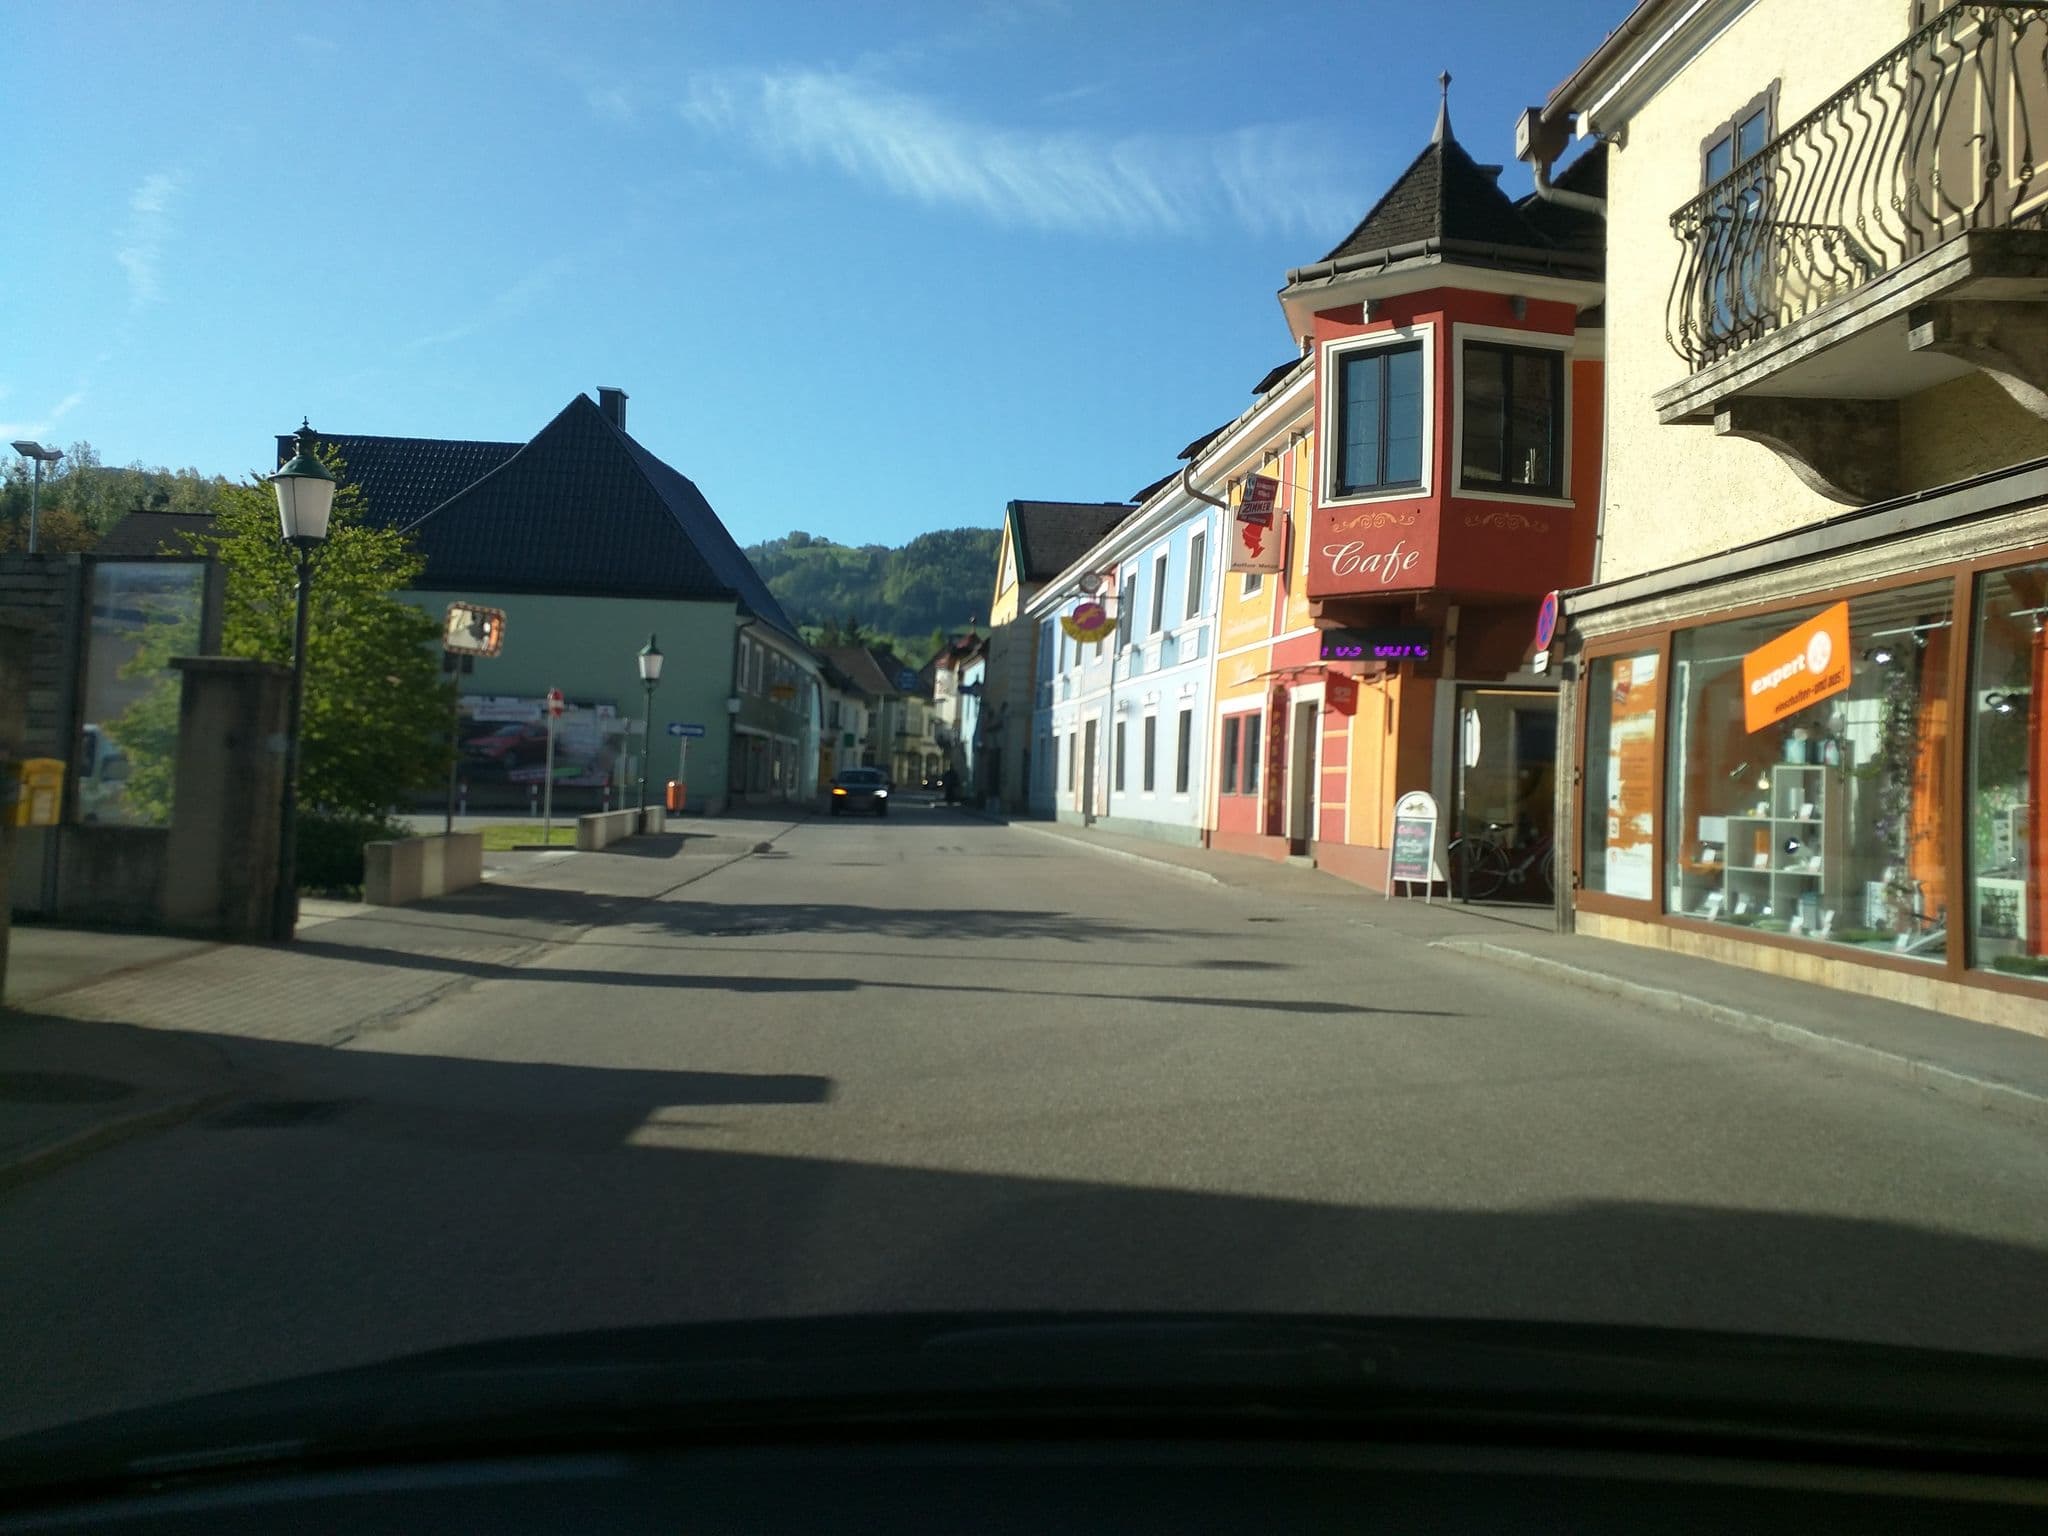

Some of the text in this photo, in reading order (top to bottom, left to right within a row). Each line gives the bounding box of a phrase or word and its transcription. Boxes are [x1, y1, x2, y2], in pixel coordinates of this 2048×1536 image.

[1242, 501, 1270, 513] ZIMMER
[1322, 539, 1420, 584] Cafe
[1751, 654, 1806, 696] expert
